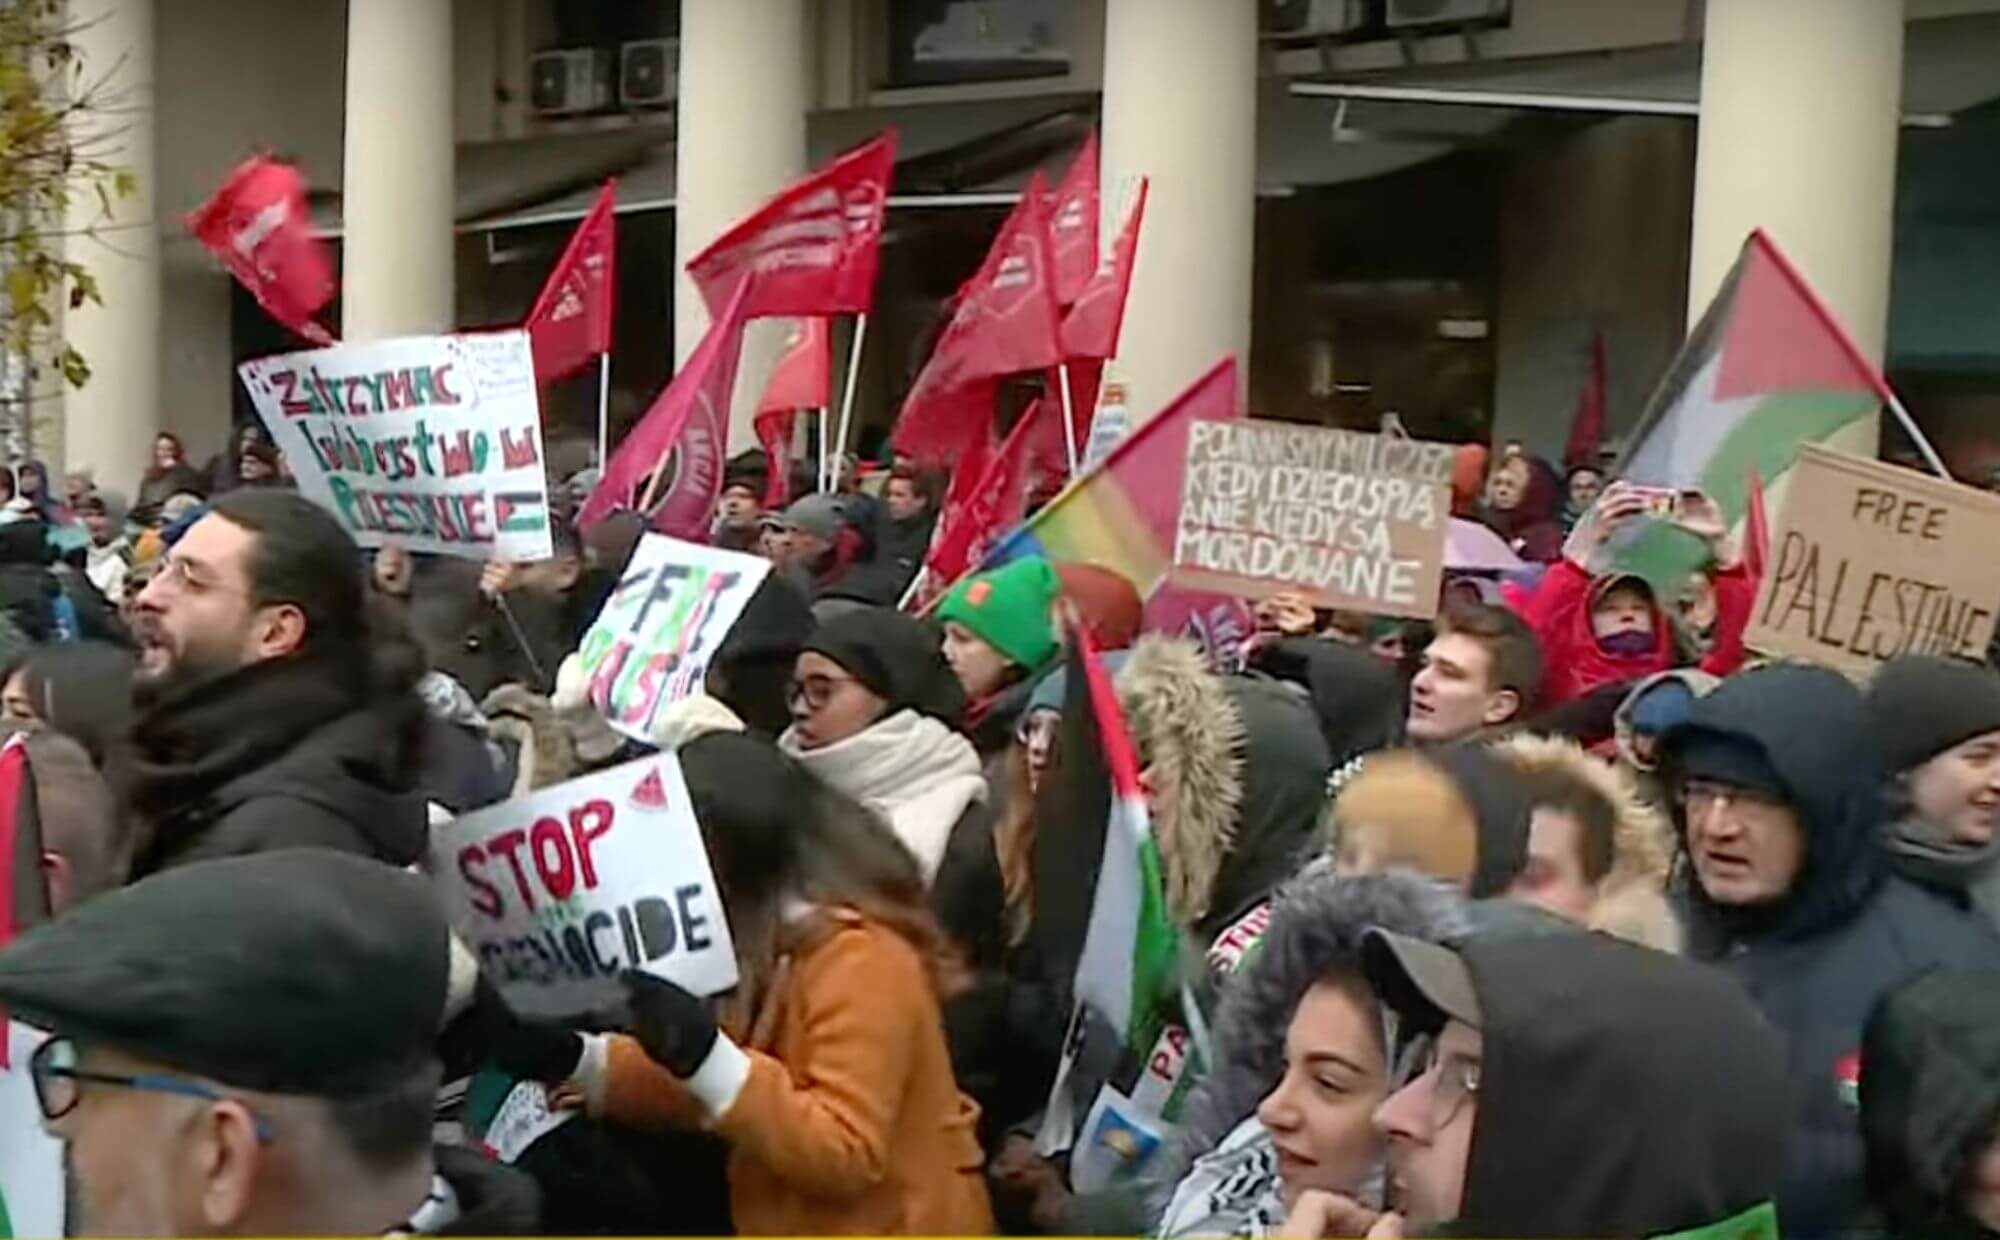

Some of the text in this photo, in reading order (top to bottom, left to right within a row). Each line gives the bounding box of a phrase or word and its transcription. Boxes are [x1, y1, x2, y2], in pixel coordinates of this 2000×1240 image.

[1853, 488, 1948, 540] FREE
[1175, 530, 1423, 603] MORDOWANE
[1760, 531, 1990, 662] PALESTINE
[458, 798, 615, 919] STOP
